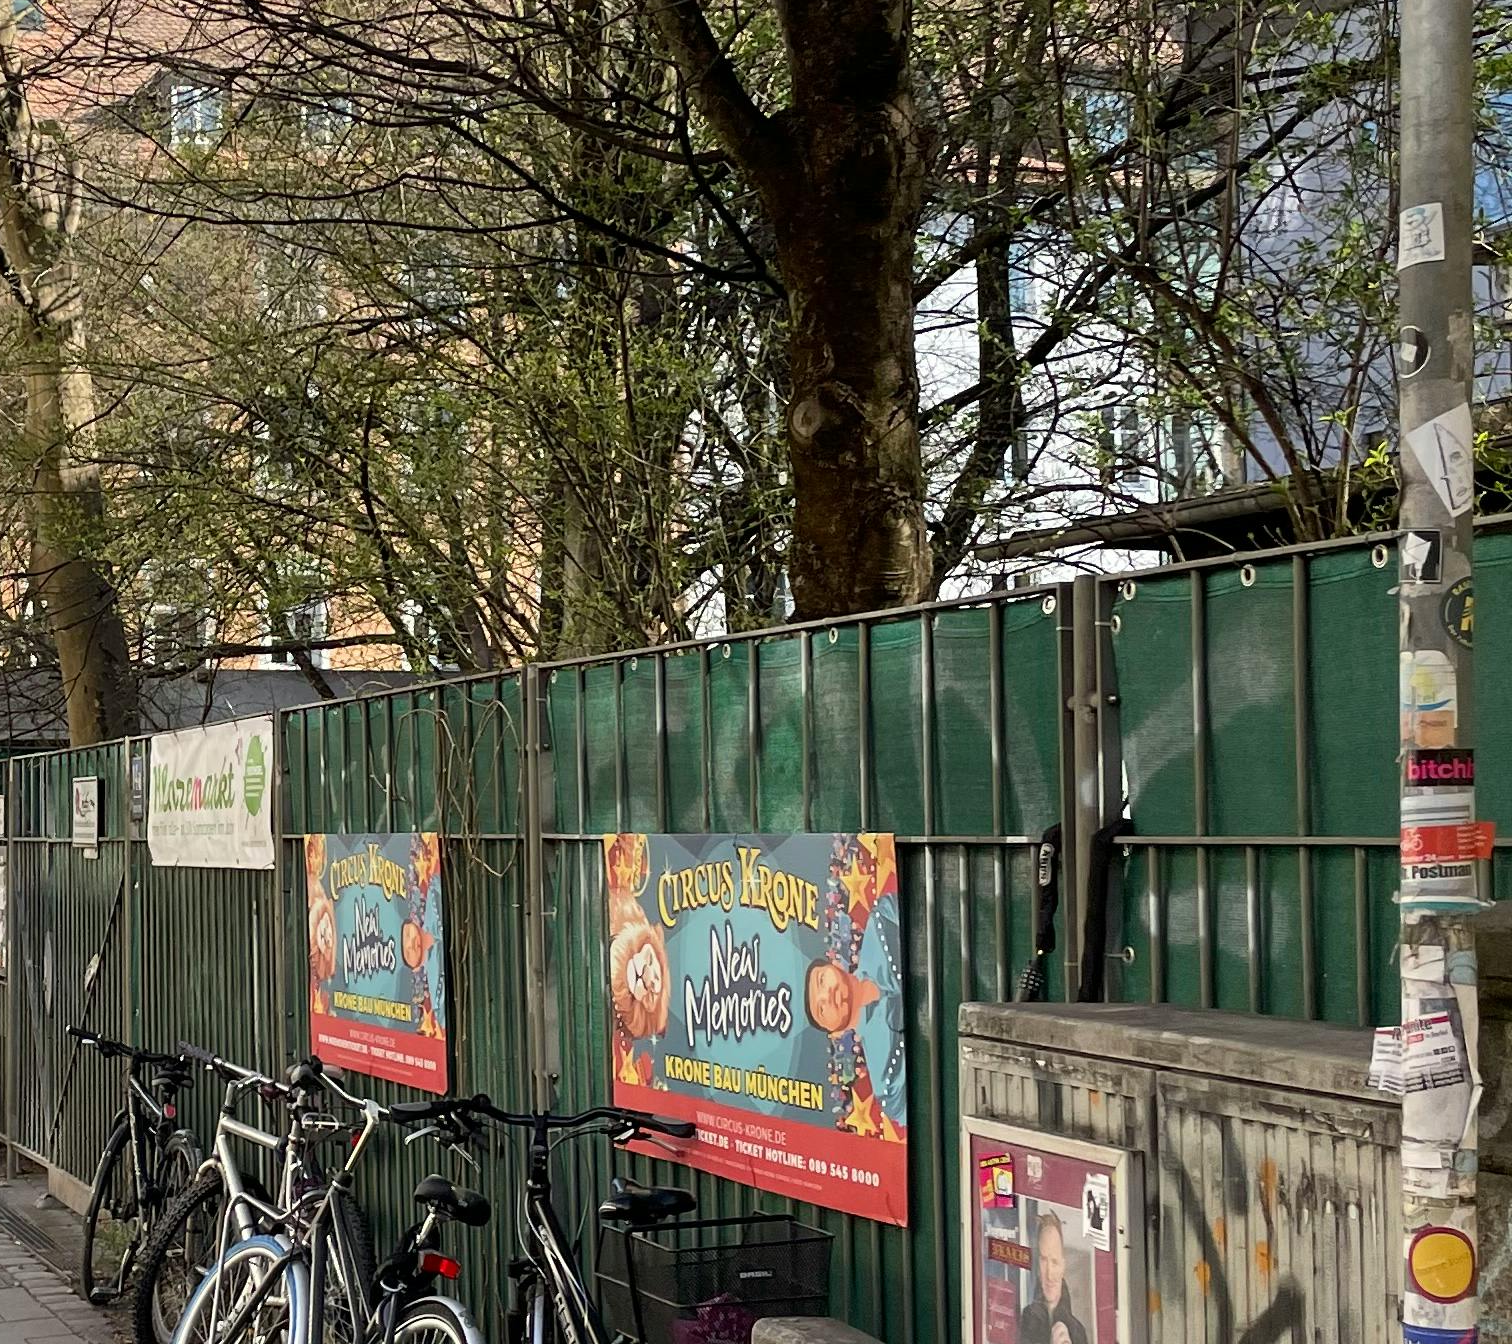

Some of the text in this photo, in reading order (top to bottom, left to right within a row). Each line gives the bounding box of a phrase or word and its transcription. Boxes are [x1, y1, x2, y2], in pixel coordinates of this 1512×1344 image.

[330, 842, 407, 902] CIRCUS KRONE
[658, 846, 821, 932] CIRCUS KRONE
[1412, 864, 1471, 879] Postman
[353, 895, 380, 948] New
[342, 934, 396, 984] Memories
[710, 921, 760, 995] New
[333, 991, 412, 1022] KRONE BAU MÜNCHEN
[684, 975, 792, 1047] Memories
[665, 1055, 824, 1111] KRONE BAU MÜNCHEN
[735, 1140, 763, 1159] TICKET
[765, 1145, 807, 1170] HOTLINE:
[808, 1158, 828, 1175] 089
[829, 1163, 849, 1181] 545
[851, 1167, 880, 1188] 8000
